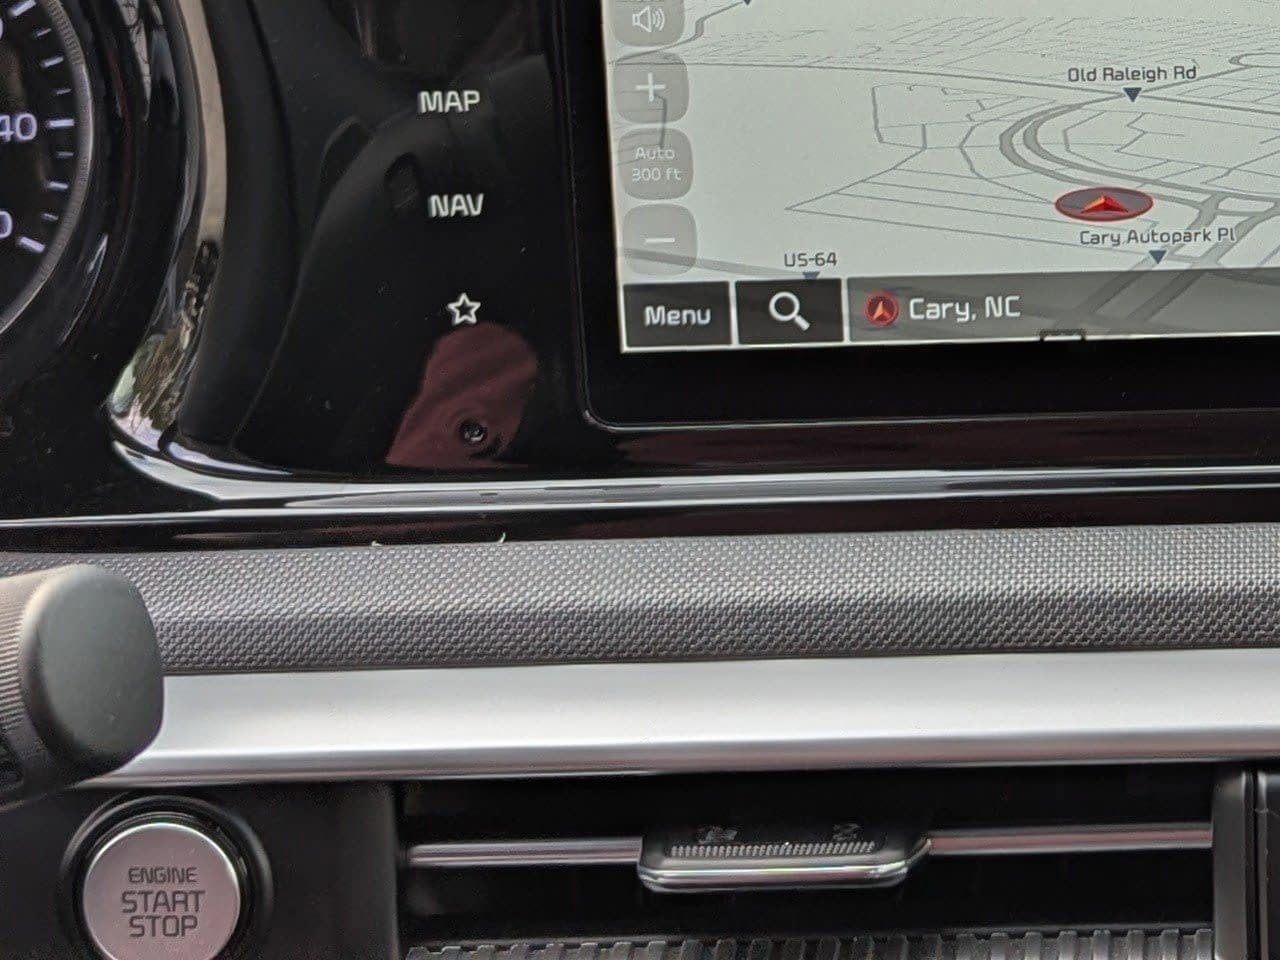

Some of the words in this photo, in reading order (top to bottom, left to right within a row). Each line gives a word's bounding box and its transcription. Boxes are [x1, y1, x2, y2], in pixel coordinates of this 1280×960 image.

[1068, 67, 1097, 83] Old
[1103, 66, 1167, 87] Raleigh
[1173, 64, 1197, 80] Rd
[419, 91, 481, 113] MAP
[634, 145, 676, 160] Auto
[632, 167, 662, 182] 300
[666, 165, 682, 182] ft
[429, 194, 484, 217] NAV
[1080, 230, 1121, 247] Cary
[1127, 229, 1212, 245] Autopark
[783, 252, 838, 268] US-64
[644, 305, 712, 327] Menu
[908, 298, 978, 324] Cary,
[984, 296, 1021, 319] NC
[128, 867, 198, 884] ENGINE
[121, 890, 205, 913] START
[129, 915, 198, 938] STOP
